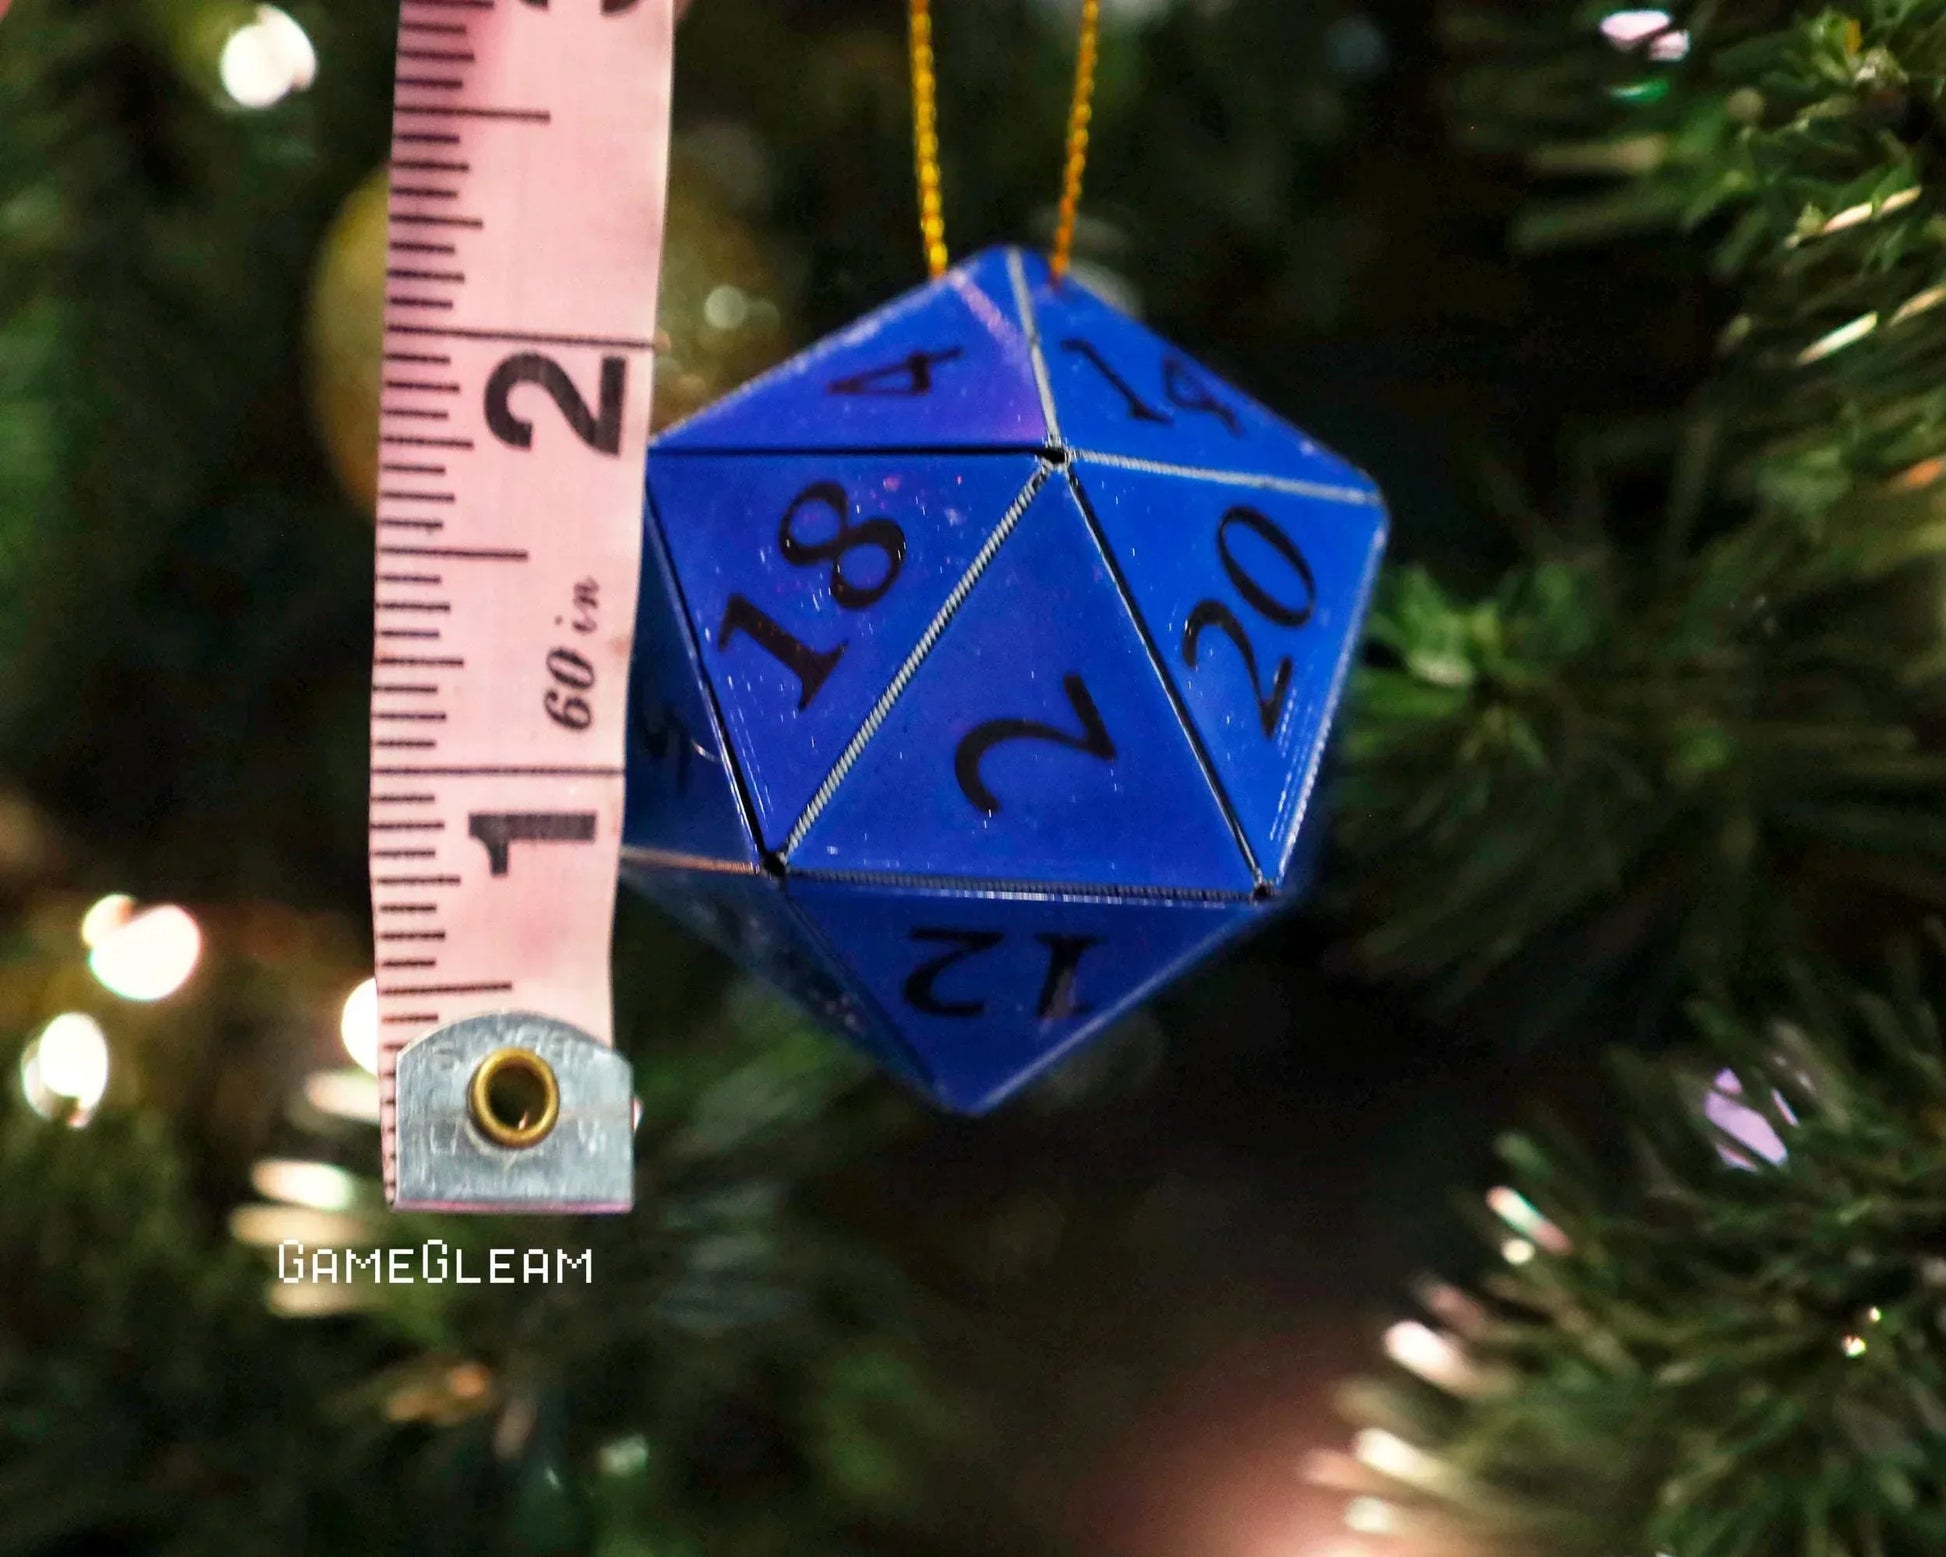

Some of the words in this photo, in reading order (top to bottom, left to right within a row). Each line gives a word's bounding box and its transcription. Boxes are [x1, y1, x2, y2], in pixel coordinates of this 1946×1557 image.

[484, 350, 627, 457] 2
[830, 346, 963, 396] 4
[1060, 337, 1248, 438] 14
[555, 575, 600, 632] in
[717, 481, 907, 711] 18
[1181, 504, 1317, 739] 20
[544, 646, 598, 732] 60
[954, 674, 1117, 815] 2
[468, 811, 597, 877] 1
[903, 926, 1112, 1019] 12
